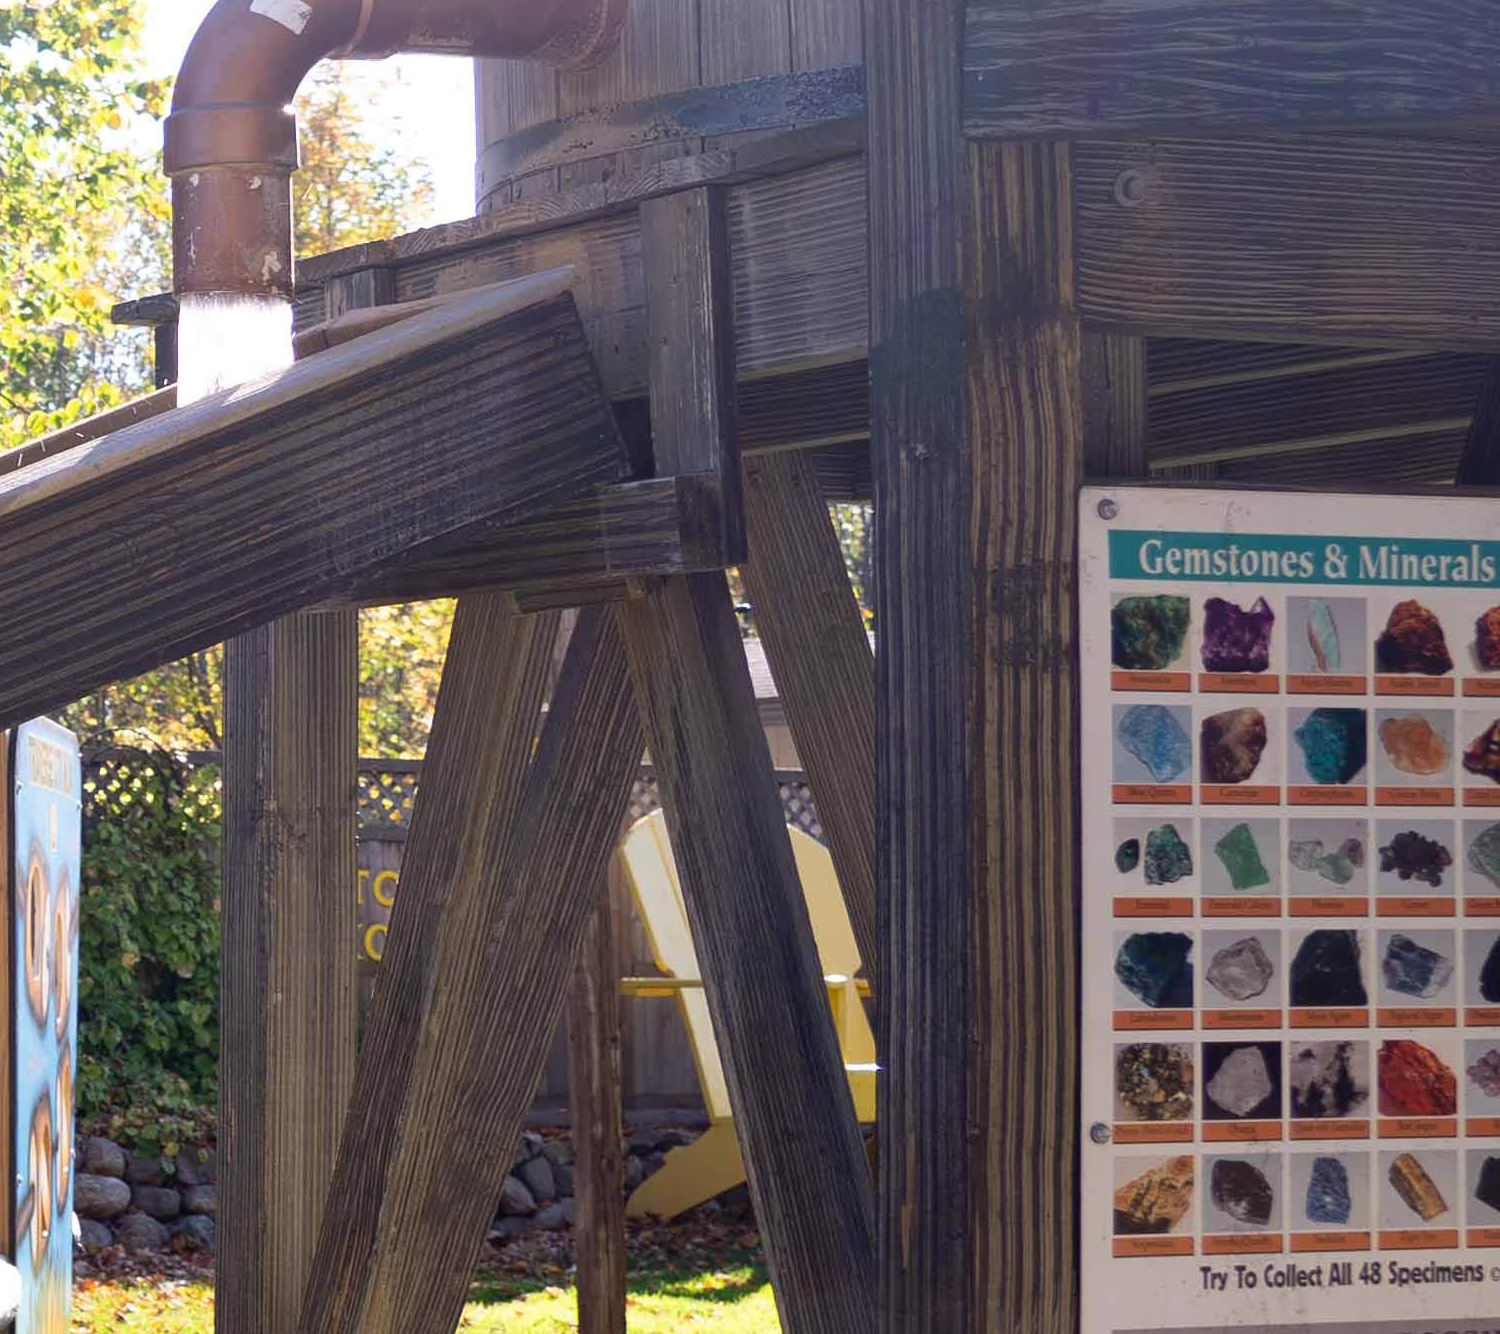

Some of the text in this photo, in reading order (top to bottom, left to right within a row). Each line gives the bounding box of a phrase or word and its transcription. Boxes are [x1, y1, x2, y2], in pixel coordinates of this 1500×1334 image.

[1138, 538, 1496, 583] Gemstones & Minerals
[1201, 1266, 1228, 1291] Try
[1235, 1265, 1257, 1288] To
[1264, 1263, 1323, 1288] Collect
[1329, 1261, 1351, 1286] All
[1359, 1261, 1381, 1285] 48
[1388, 1260, 1484, 1288] Specimens
